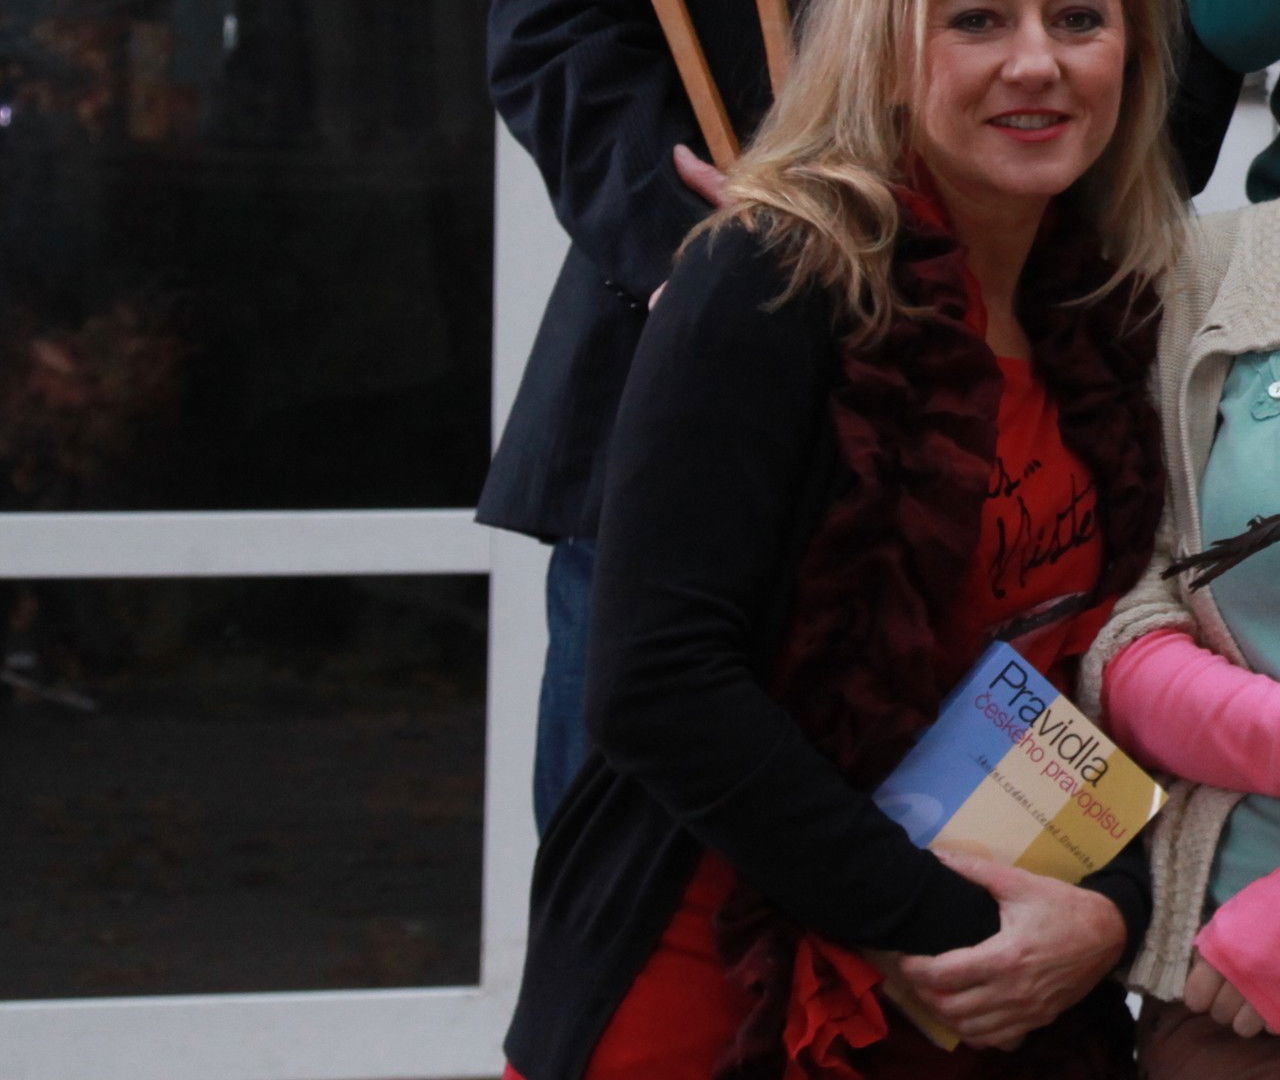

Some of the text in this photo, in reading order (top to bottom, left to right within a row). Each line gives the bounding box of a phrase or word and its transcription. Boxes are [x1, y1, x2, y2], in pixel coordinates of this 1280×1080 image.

[975, 692, 1127, 840] českého pravopisu
[989, 660, 1109, 787] Pravidla
